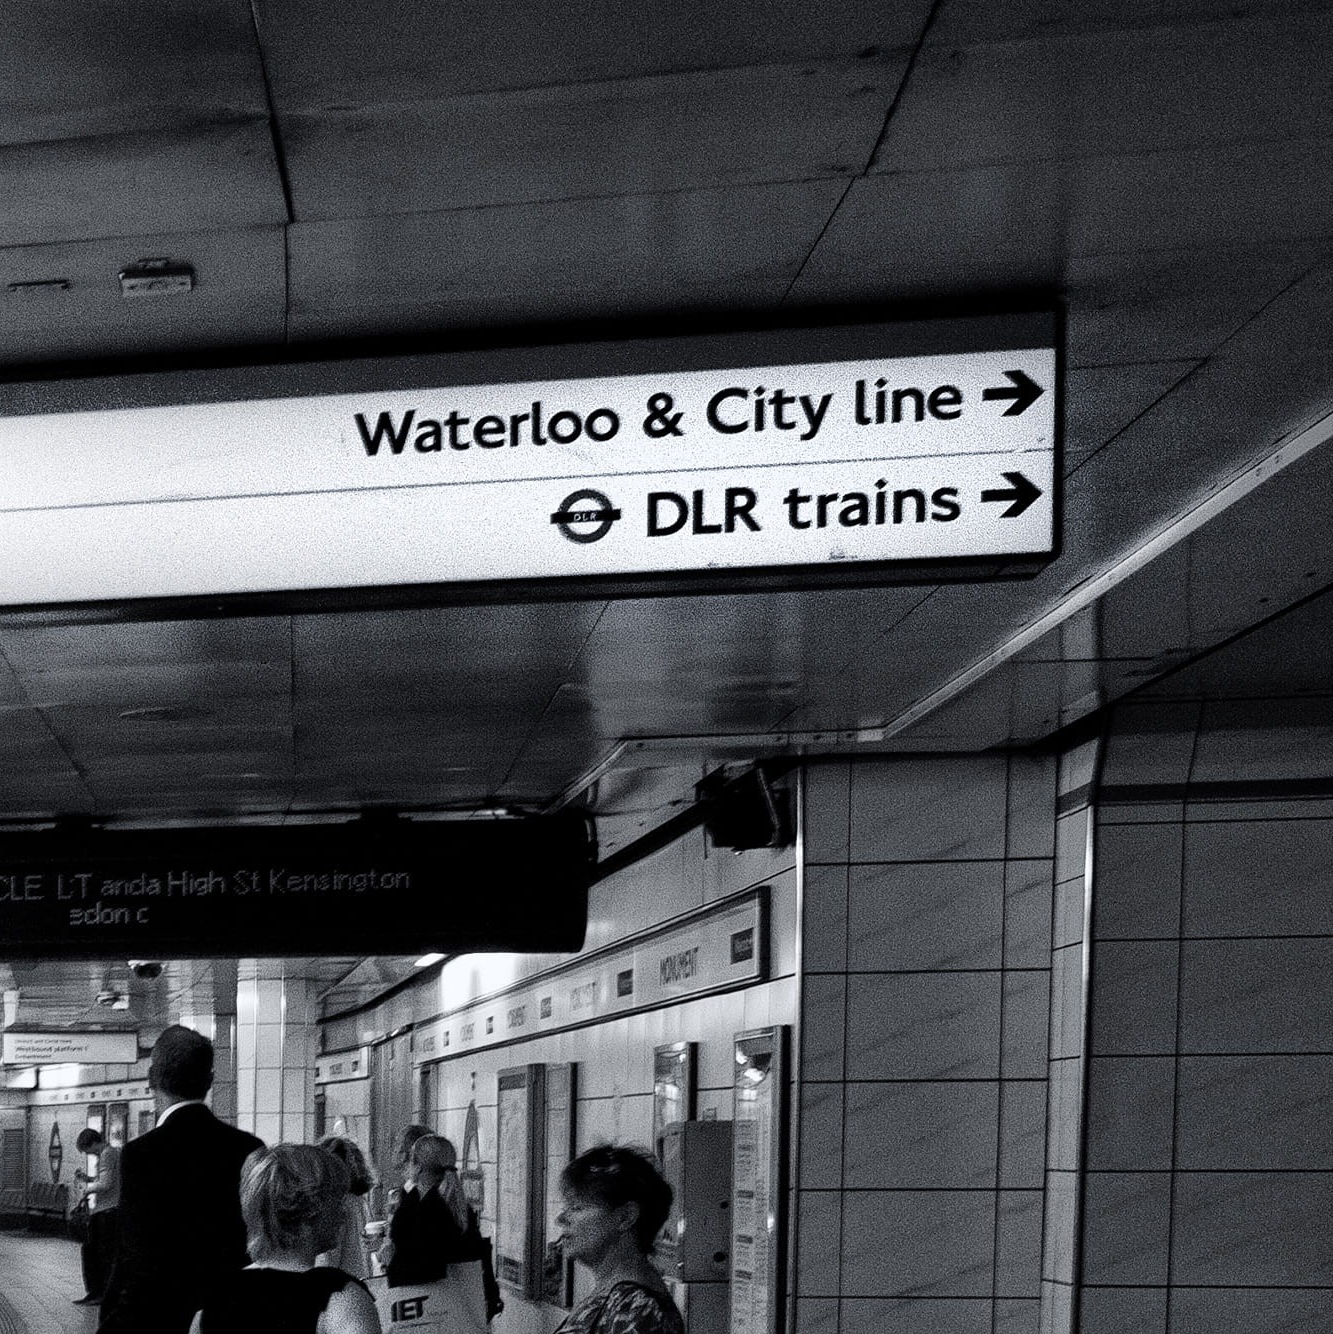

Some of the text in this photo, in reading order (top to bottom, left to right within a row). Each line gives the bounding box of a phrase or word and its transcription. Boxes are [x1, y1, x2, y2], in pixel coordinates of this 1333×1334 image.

[354, 378, 963, 456] Waterloo & City line
[646, 478, 961, 537] DLR trains
[167, 870, 226, 896] High
[233, 869, 262, 895] St
[269, 868, 411, 892] Kensington
[660, 946, 698, 985] MONUMENT
